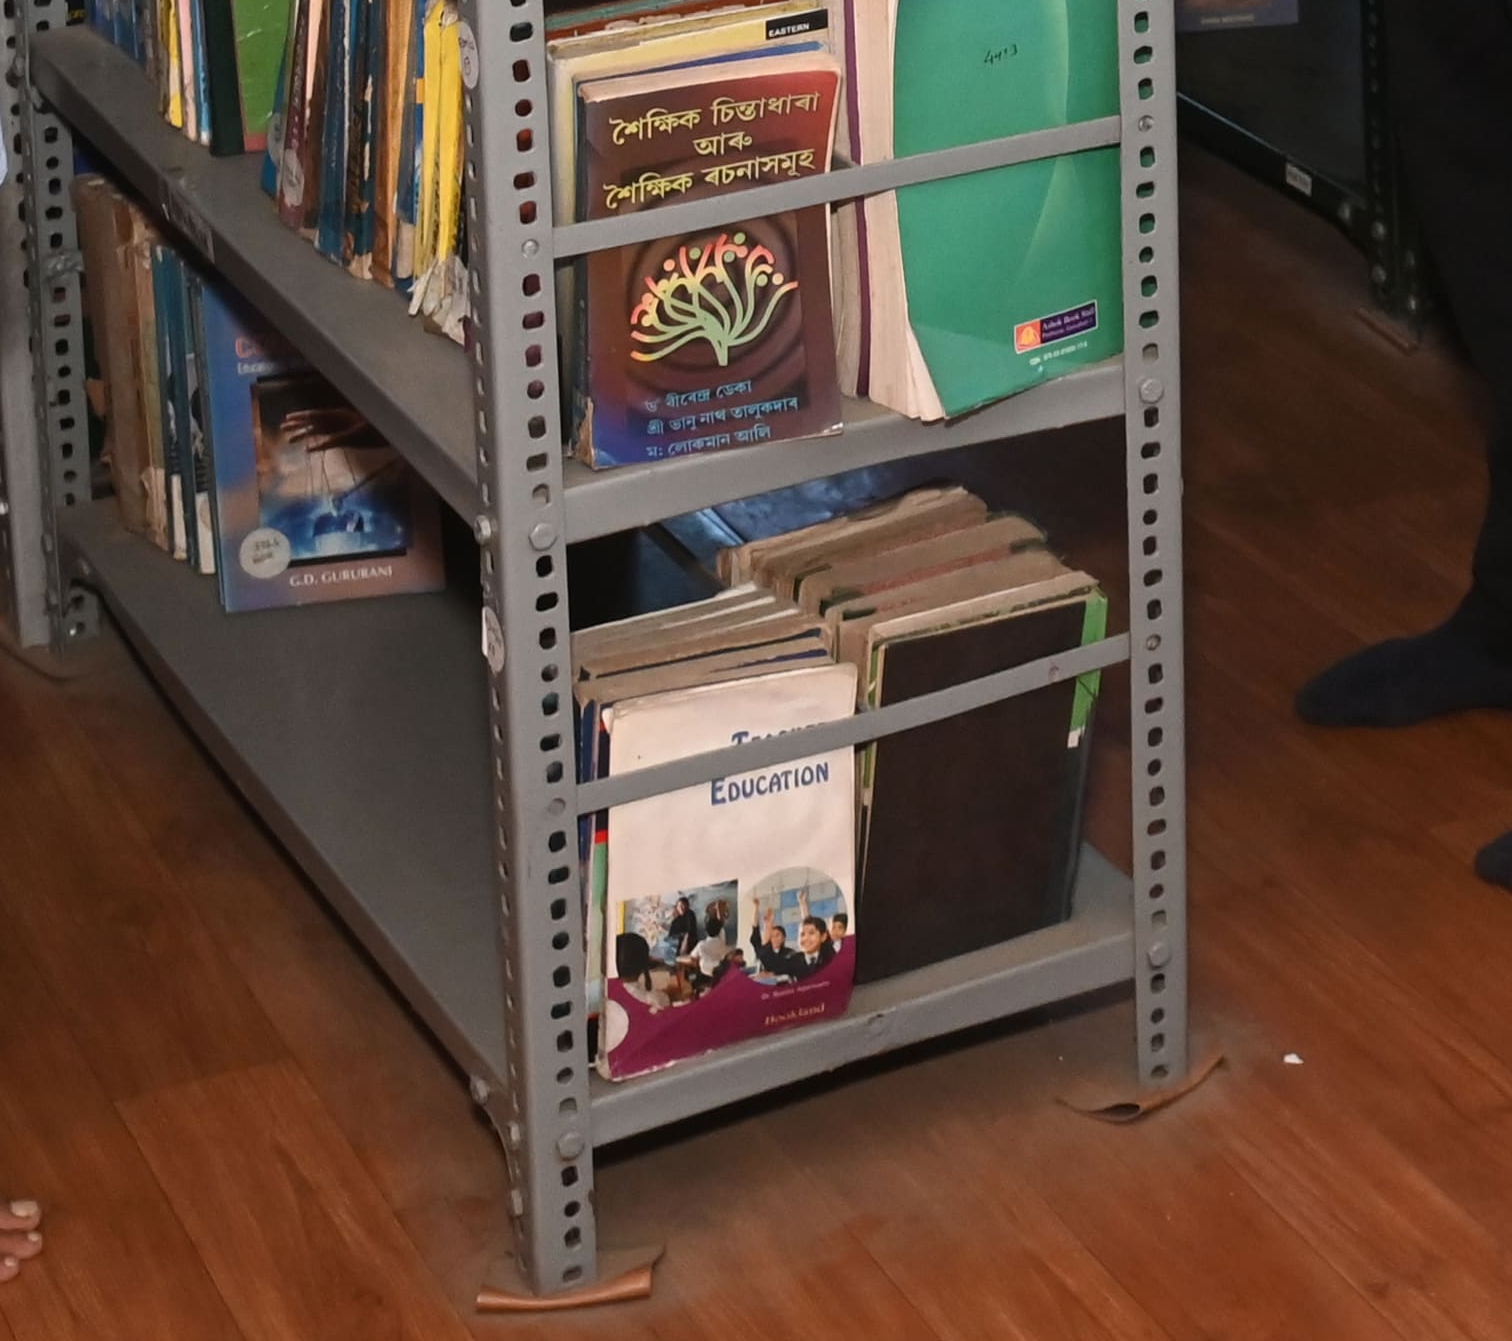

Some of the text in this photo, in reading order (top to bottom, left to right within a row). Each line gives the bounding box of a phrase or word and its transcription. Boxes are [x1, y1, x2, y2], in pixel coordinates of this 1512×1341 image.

[769, 23, 810, 37] EASTERN
[289, 565, 392, 587] G.D. GURURANI
[711, 763, 829, 805] EDUCATION
